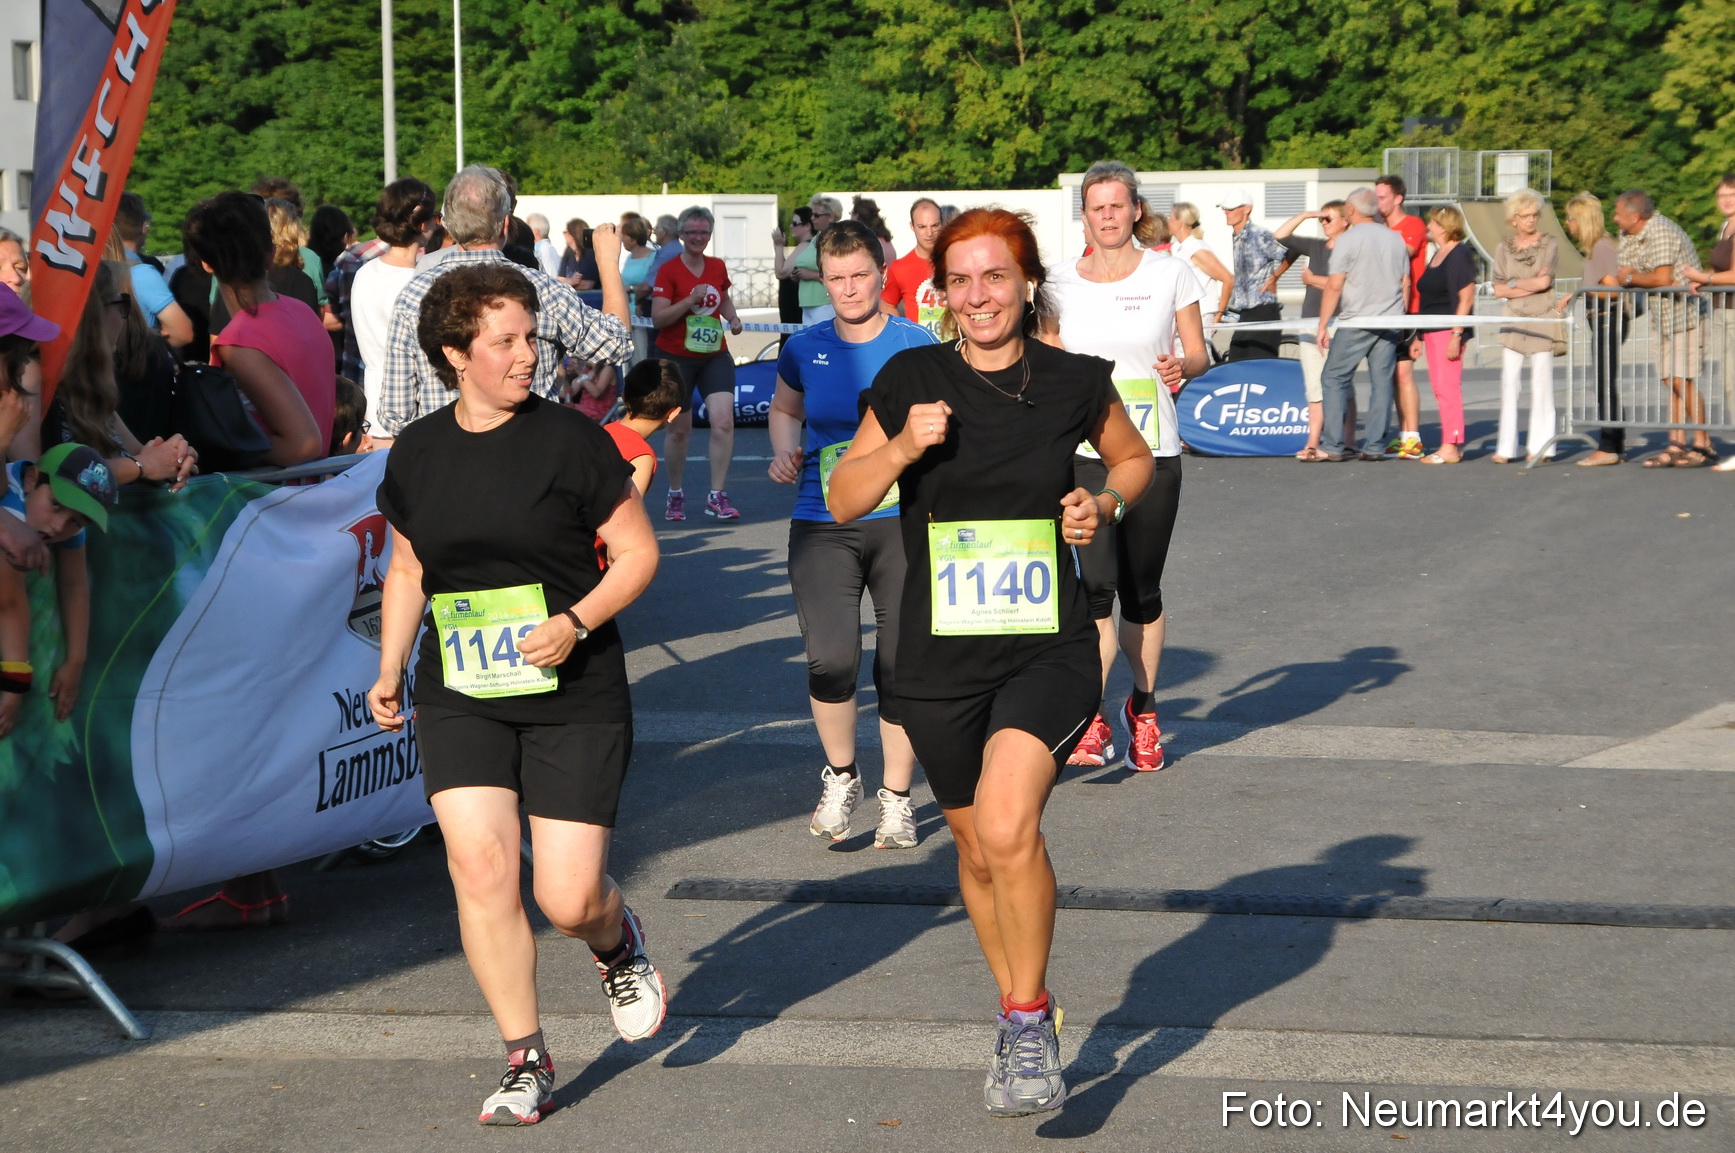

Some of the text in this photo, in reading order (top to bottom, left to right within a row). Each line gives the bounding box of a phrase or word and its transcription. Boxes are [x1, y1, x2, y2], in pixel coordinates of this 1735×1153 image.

[35, 0, 163, 274] WECH
[691, 327, 719, 344] 453
[812, 358, 829, 366] erima
[949, 539, 993, 549] firmenlauf
[937, 561, 1051, 605] 1140
[450, 608, 486, 619] firmenlauf
[970, 607, 1020, 616] Agnes Schlierf
[475, 670, 522, 681] Birgit Marschall
[315, 719, 422, 813] Lammsb
